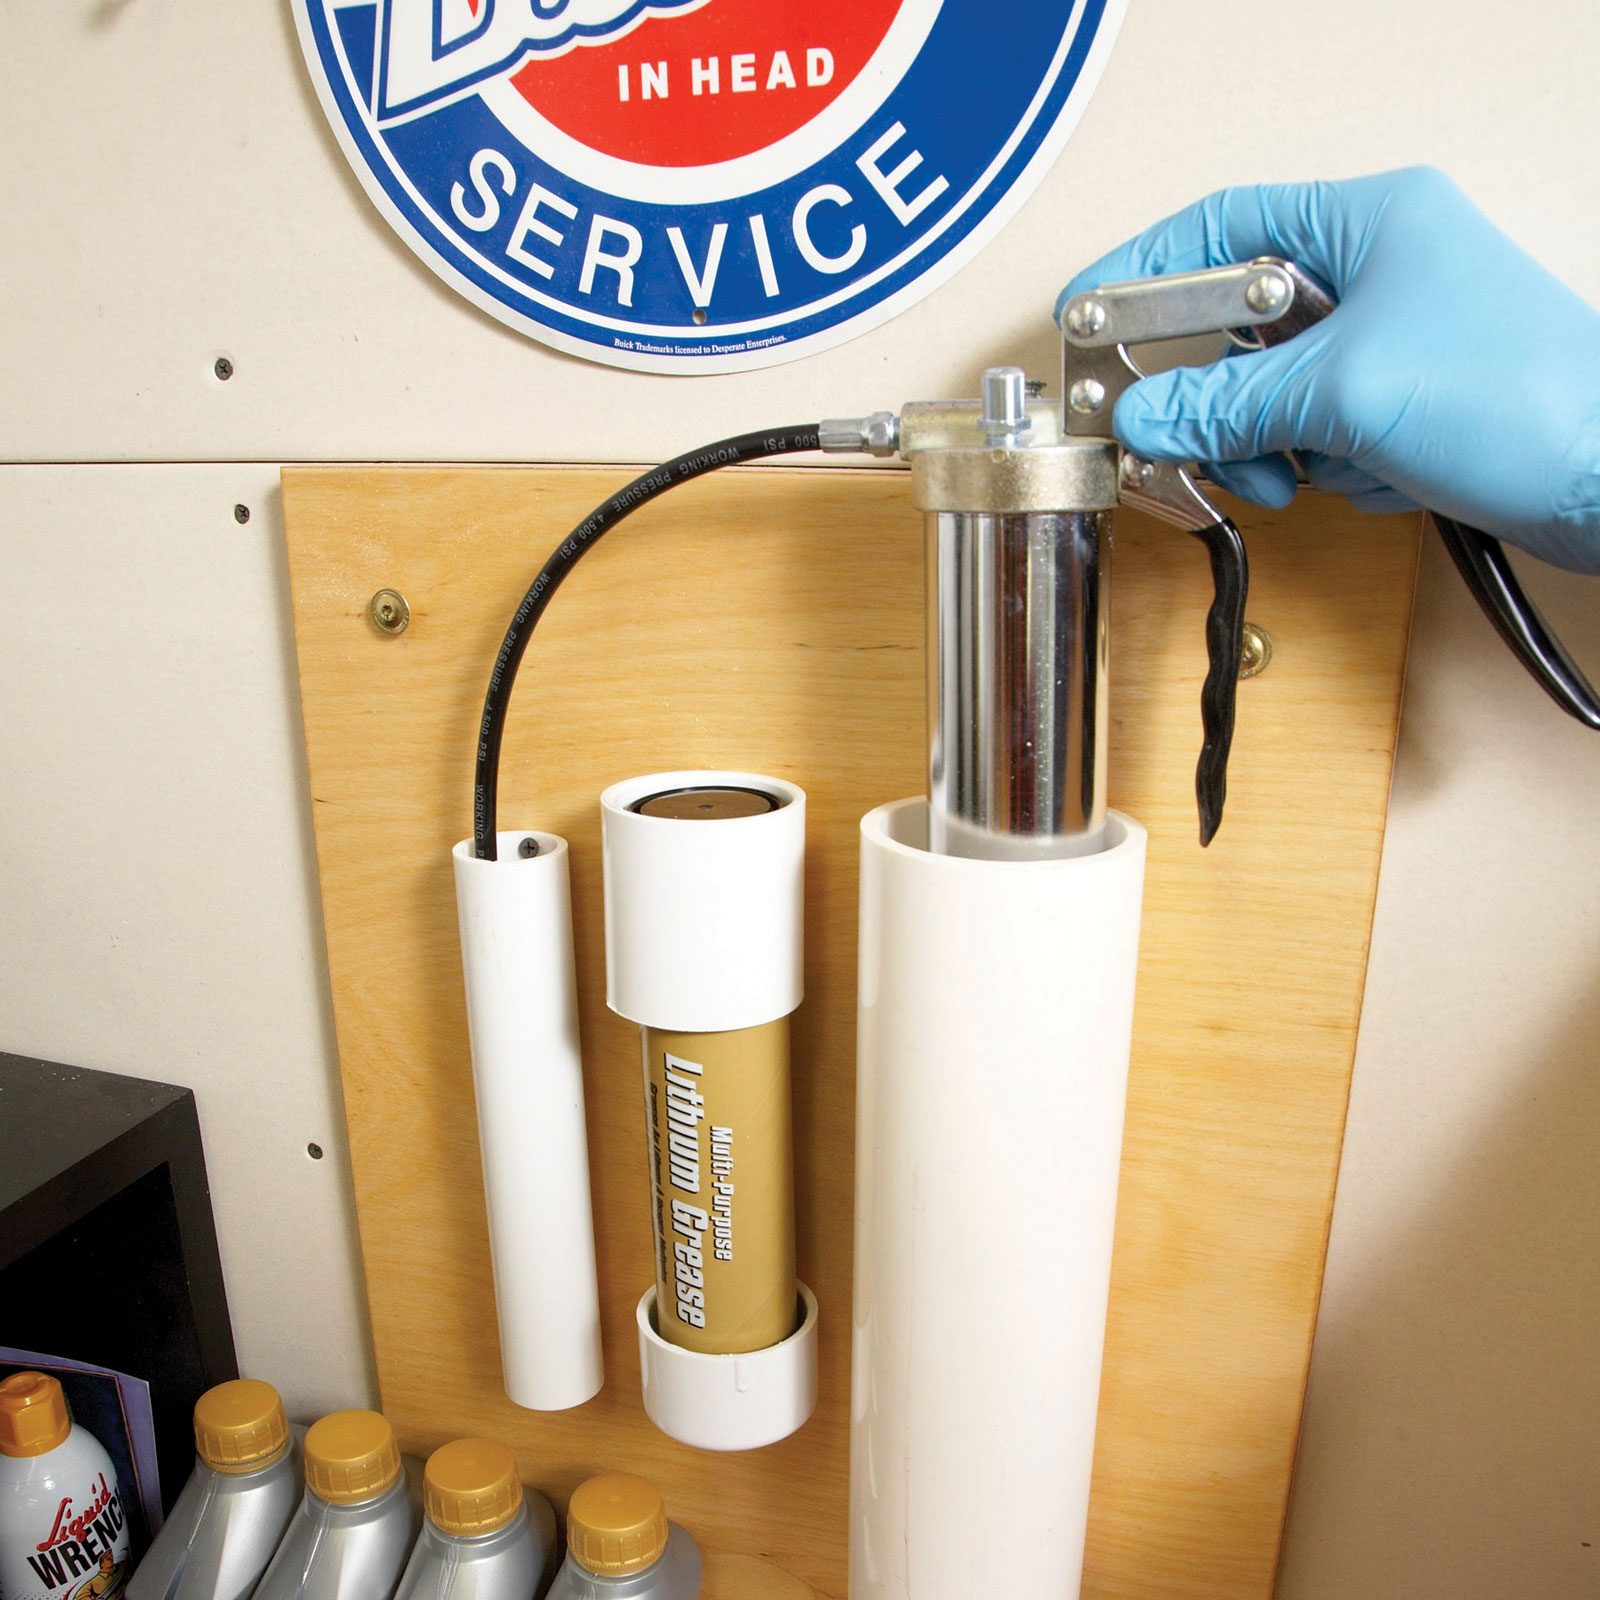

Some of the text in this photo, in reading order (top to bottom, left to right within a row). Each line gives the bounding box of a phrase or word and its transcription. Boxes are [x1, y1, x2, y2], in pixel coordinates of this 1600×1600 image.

[618, 61, 668, 102] IN
[691, 47, 835, 96] HEAD
[449, 120, 950, 308] SERVICE
[614, 338, 634, 349] Buick
[635, 341, 674, 354] Trademarks
[674, 345, 703, 354] licensed
[704, 346, 711, 354] to
[711, 343, 746, 354] Desperate
[763, 438, 787, 451] PSI
[559, 446, 741, 560] WORKING PRESSURE 4,500 PSI
[515, 572, 550, 623] WORKING
[489, 629, 517, 693] PRESSURE
[475, 784, 484, 840] WORKING
[663, 1052, 709, 1330] Lithium Grease
[709, 1125, 733, 1262] Multi-Purpose
[36, 1473, 111, 1552] Liquid
